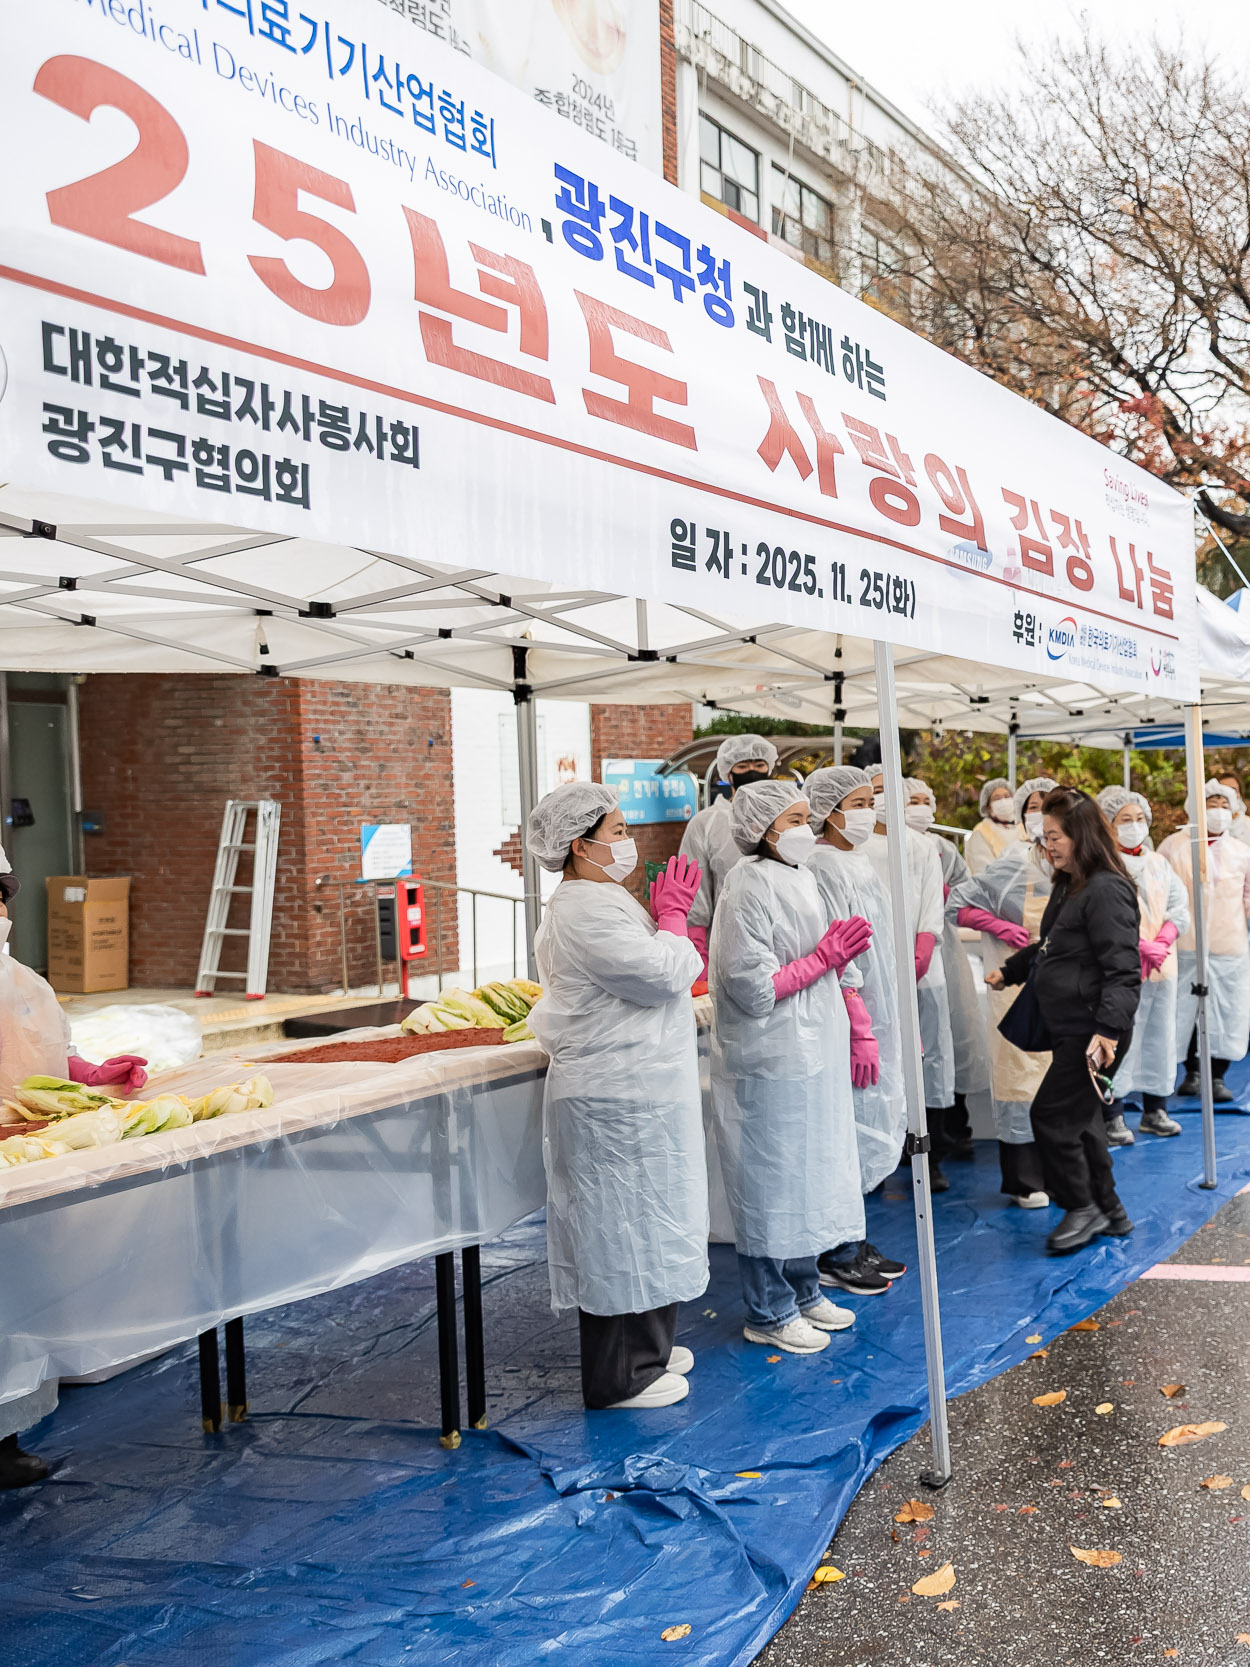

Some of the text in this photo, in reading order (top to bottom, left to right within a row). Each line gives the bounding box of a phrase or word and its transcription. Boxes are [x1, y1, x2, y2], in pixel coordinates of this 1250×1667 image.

[200, 0, 497, 169] 료기기산업협회
[212, 42, 320, 125] Devices
[327, 102, 416, 182] Industry
[425, 155, 533, 233] Association
[571, 73, 615, 123] 2024년
[554, 162, 735, 328] 광진구청
[780, 301, 835, 376] 함께
[841, 335, 886, 401] 하는
[41, 320, 421, 470] 대한적십자사봉사회
[41, 402, 311, 511] 광진구협의회
[756, 374, 988, 553] 사랑의
[1001, 487, 1094, 592] 김장
[1109, 535, 1174, 620] 나눔
[1104, 468, 1130, 502] Saving
[755, 541, 823, 599] 2025.
[831, 561, 852, 605] 11.
[859, 568, 916, 620] 25(화)
[1049, 628, 1075, 648] KMDIA
